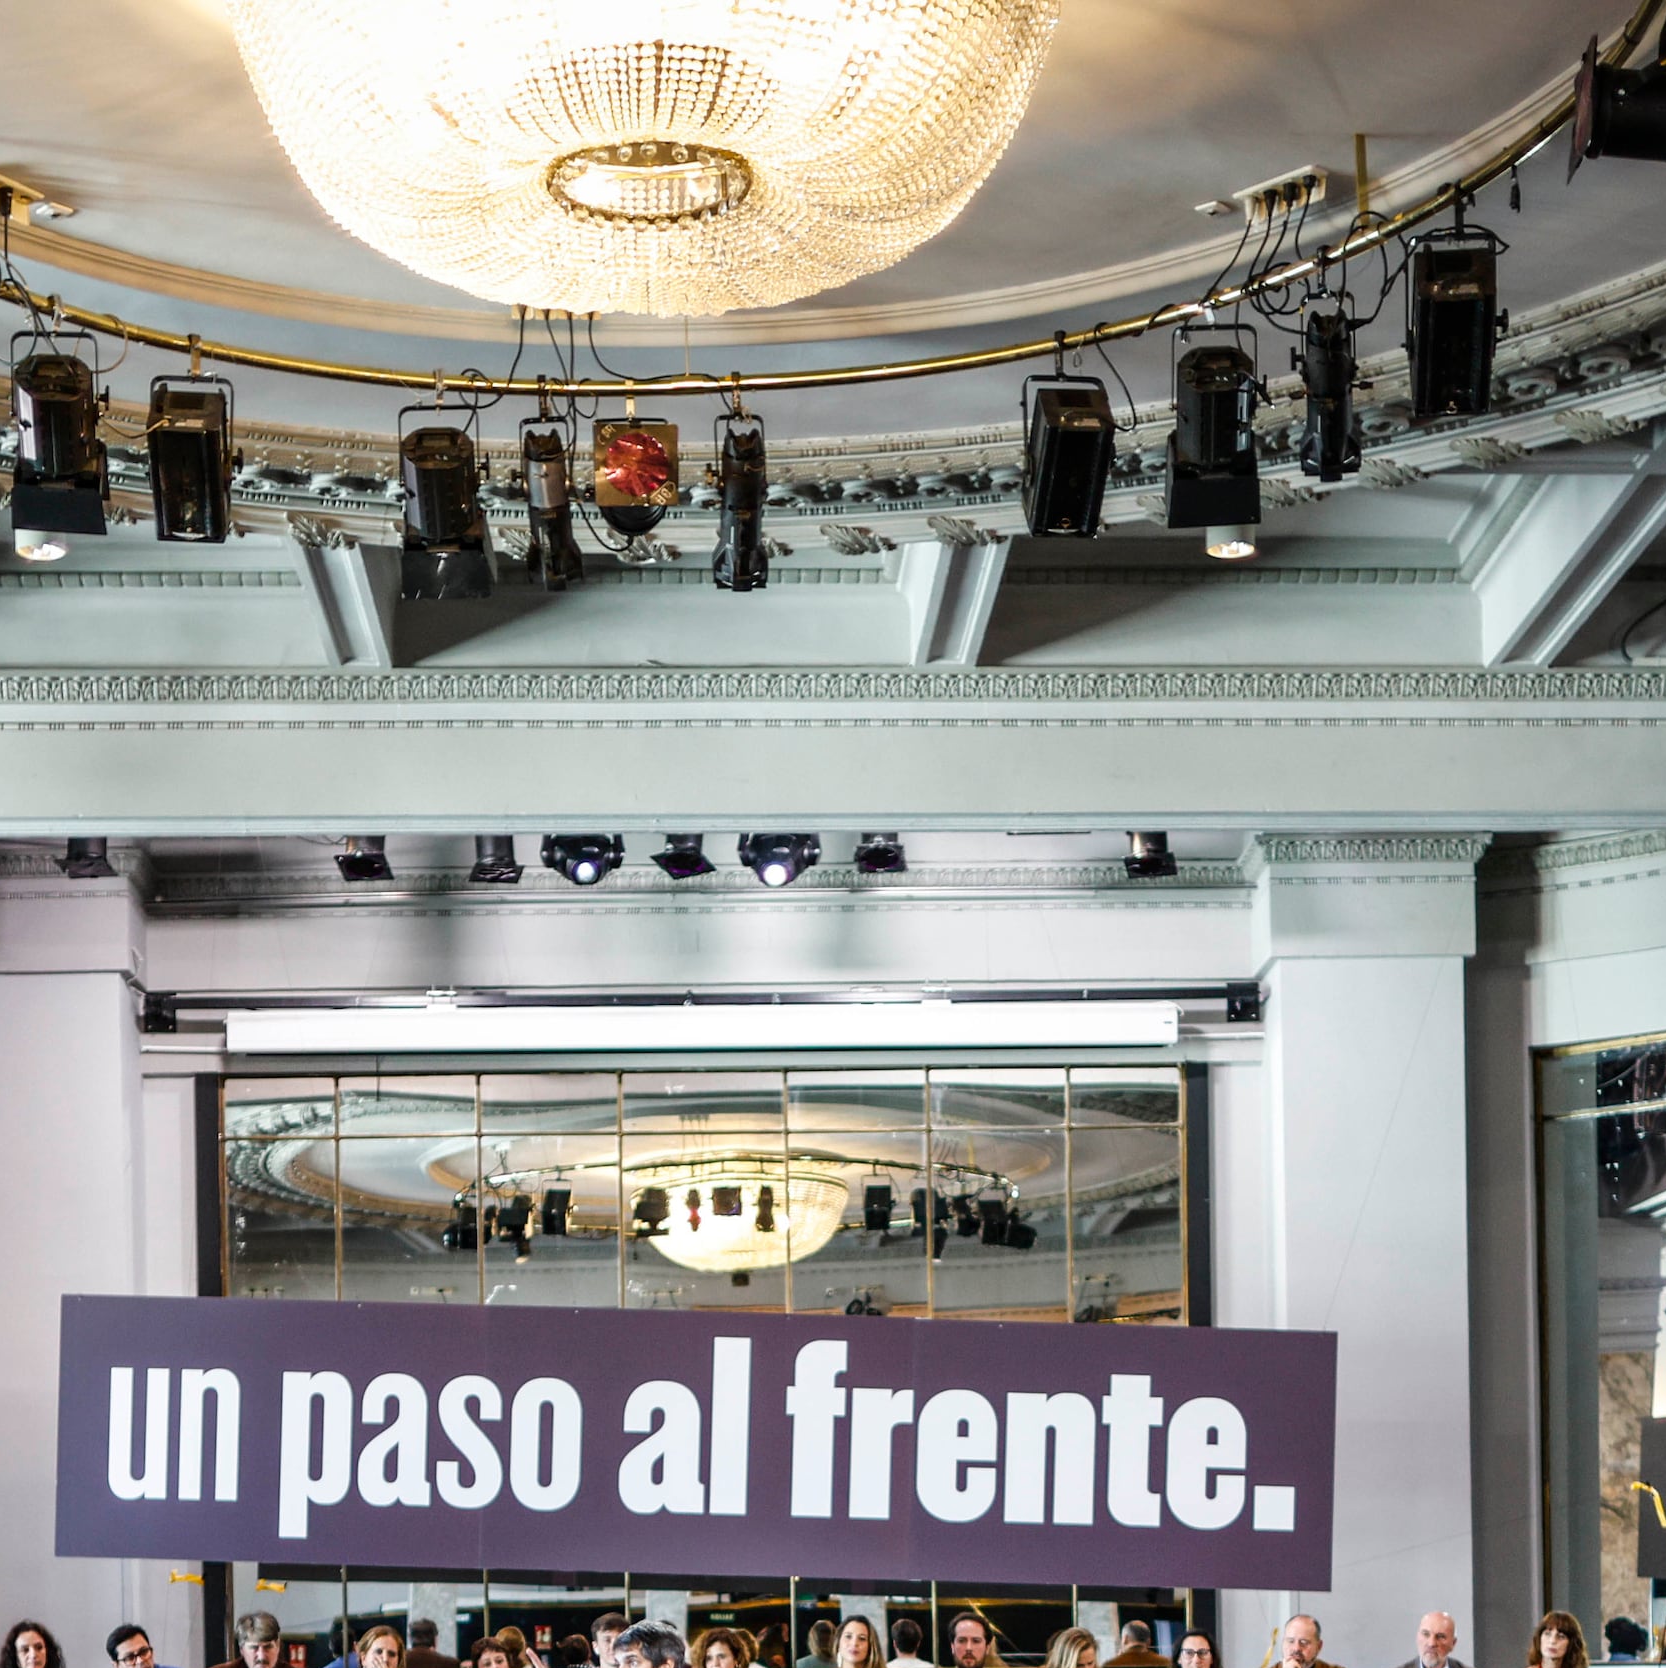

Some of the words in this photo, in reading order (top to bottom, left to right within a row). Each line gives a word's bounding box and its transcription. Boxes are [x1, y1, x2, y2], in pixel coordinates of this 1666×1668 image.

[108, 1367, 240, 1501] un
[279, 1372, 581, 1538] paso
[619, 1337, 751, 1515] al
[786, 1340, 1294, 1530] frente.
